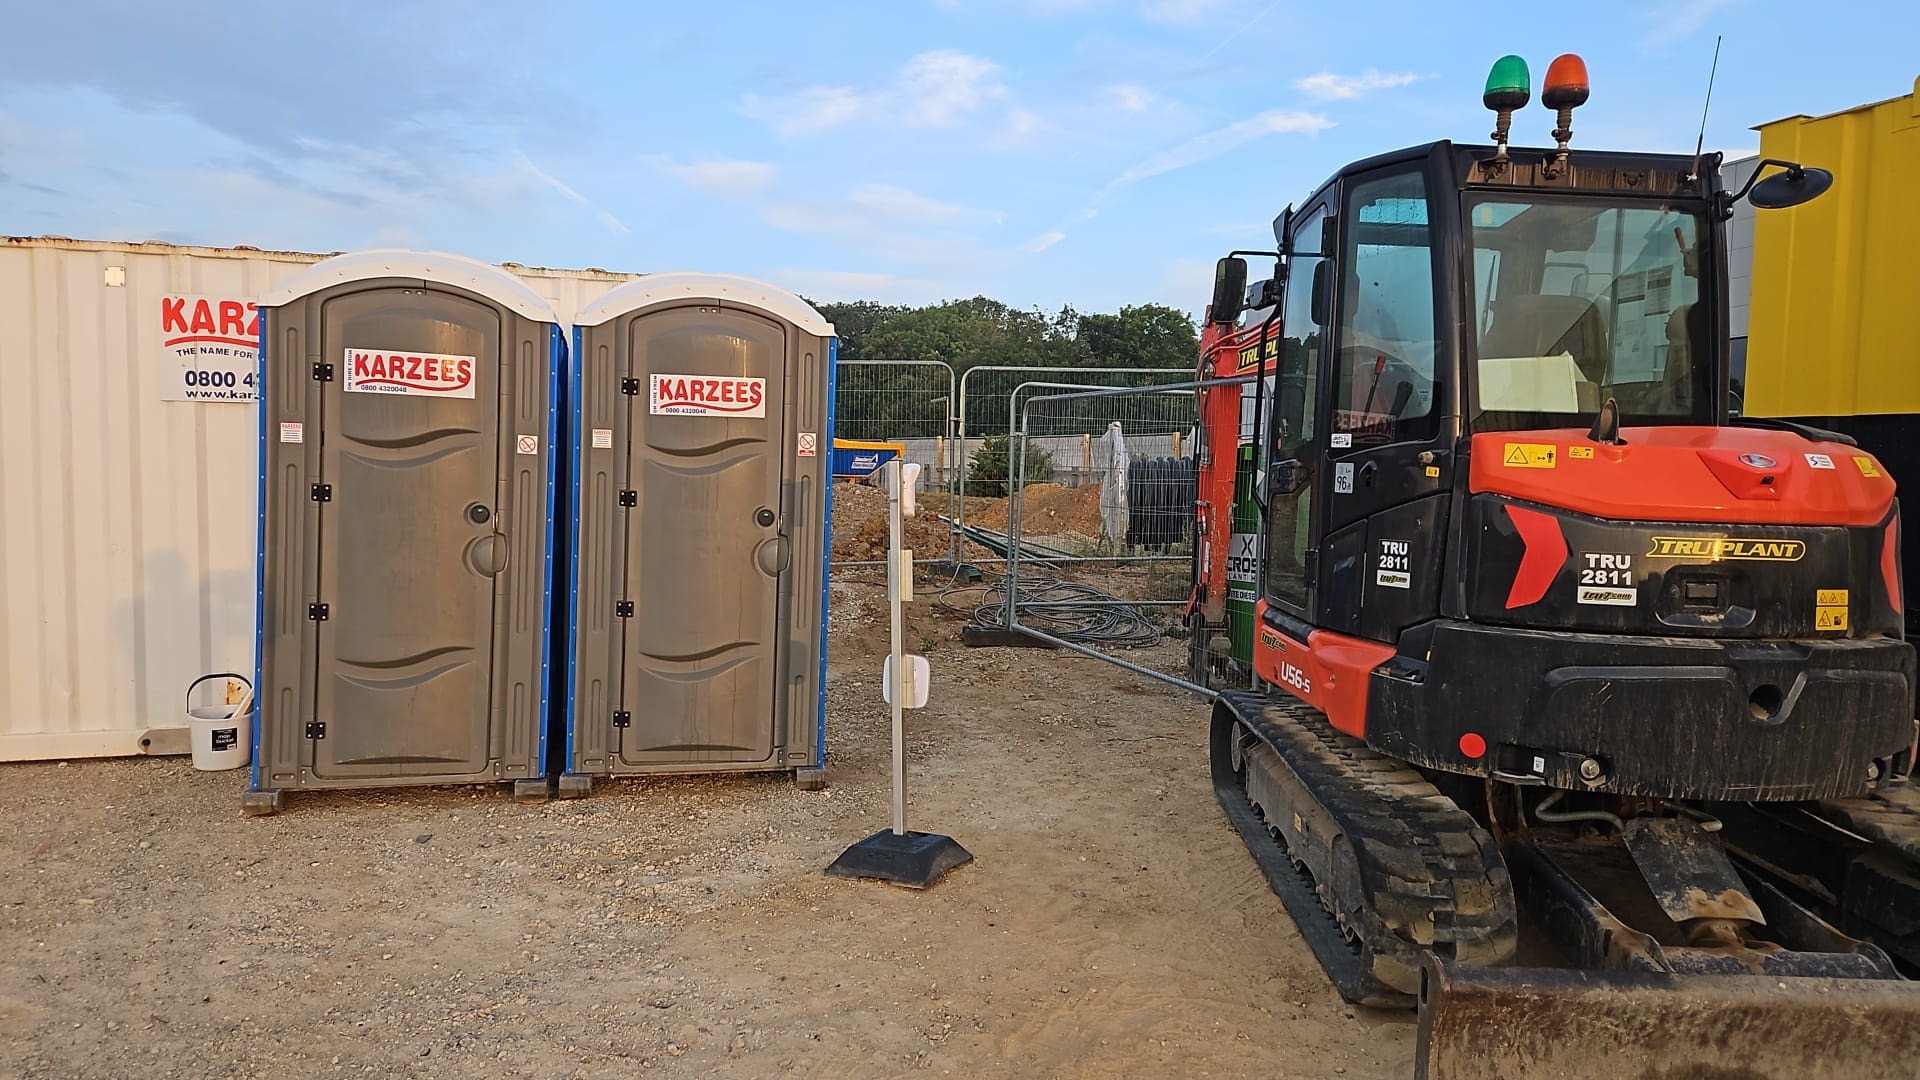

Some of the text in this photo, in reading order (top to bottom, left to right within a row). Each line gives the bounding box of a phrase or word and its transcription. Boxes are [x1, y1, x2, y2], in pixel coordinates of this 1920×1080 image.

[176, 347, 253, 359] THE NAME FOR
[355, 353, 471, 385] KARZEES
[185, 370, 259, 388] 0800 4
[379, 385, 407, 393] 4320048
[659, 378, 761, 405] KARZEES
[1381, 541, 1408, 556] TRU
[1379, 555, 1408, 570] 2811
[1585, 553, 1631, 570] TRU
[1581, 569, 1632, 586] 2811
